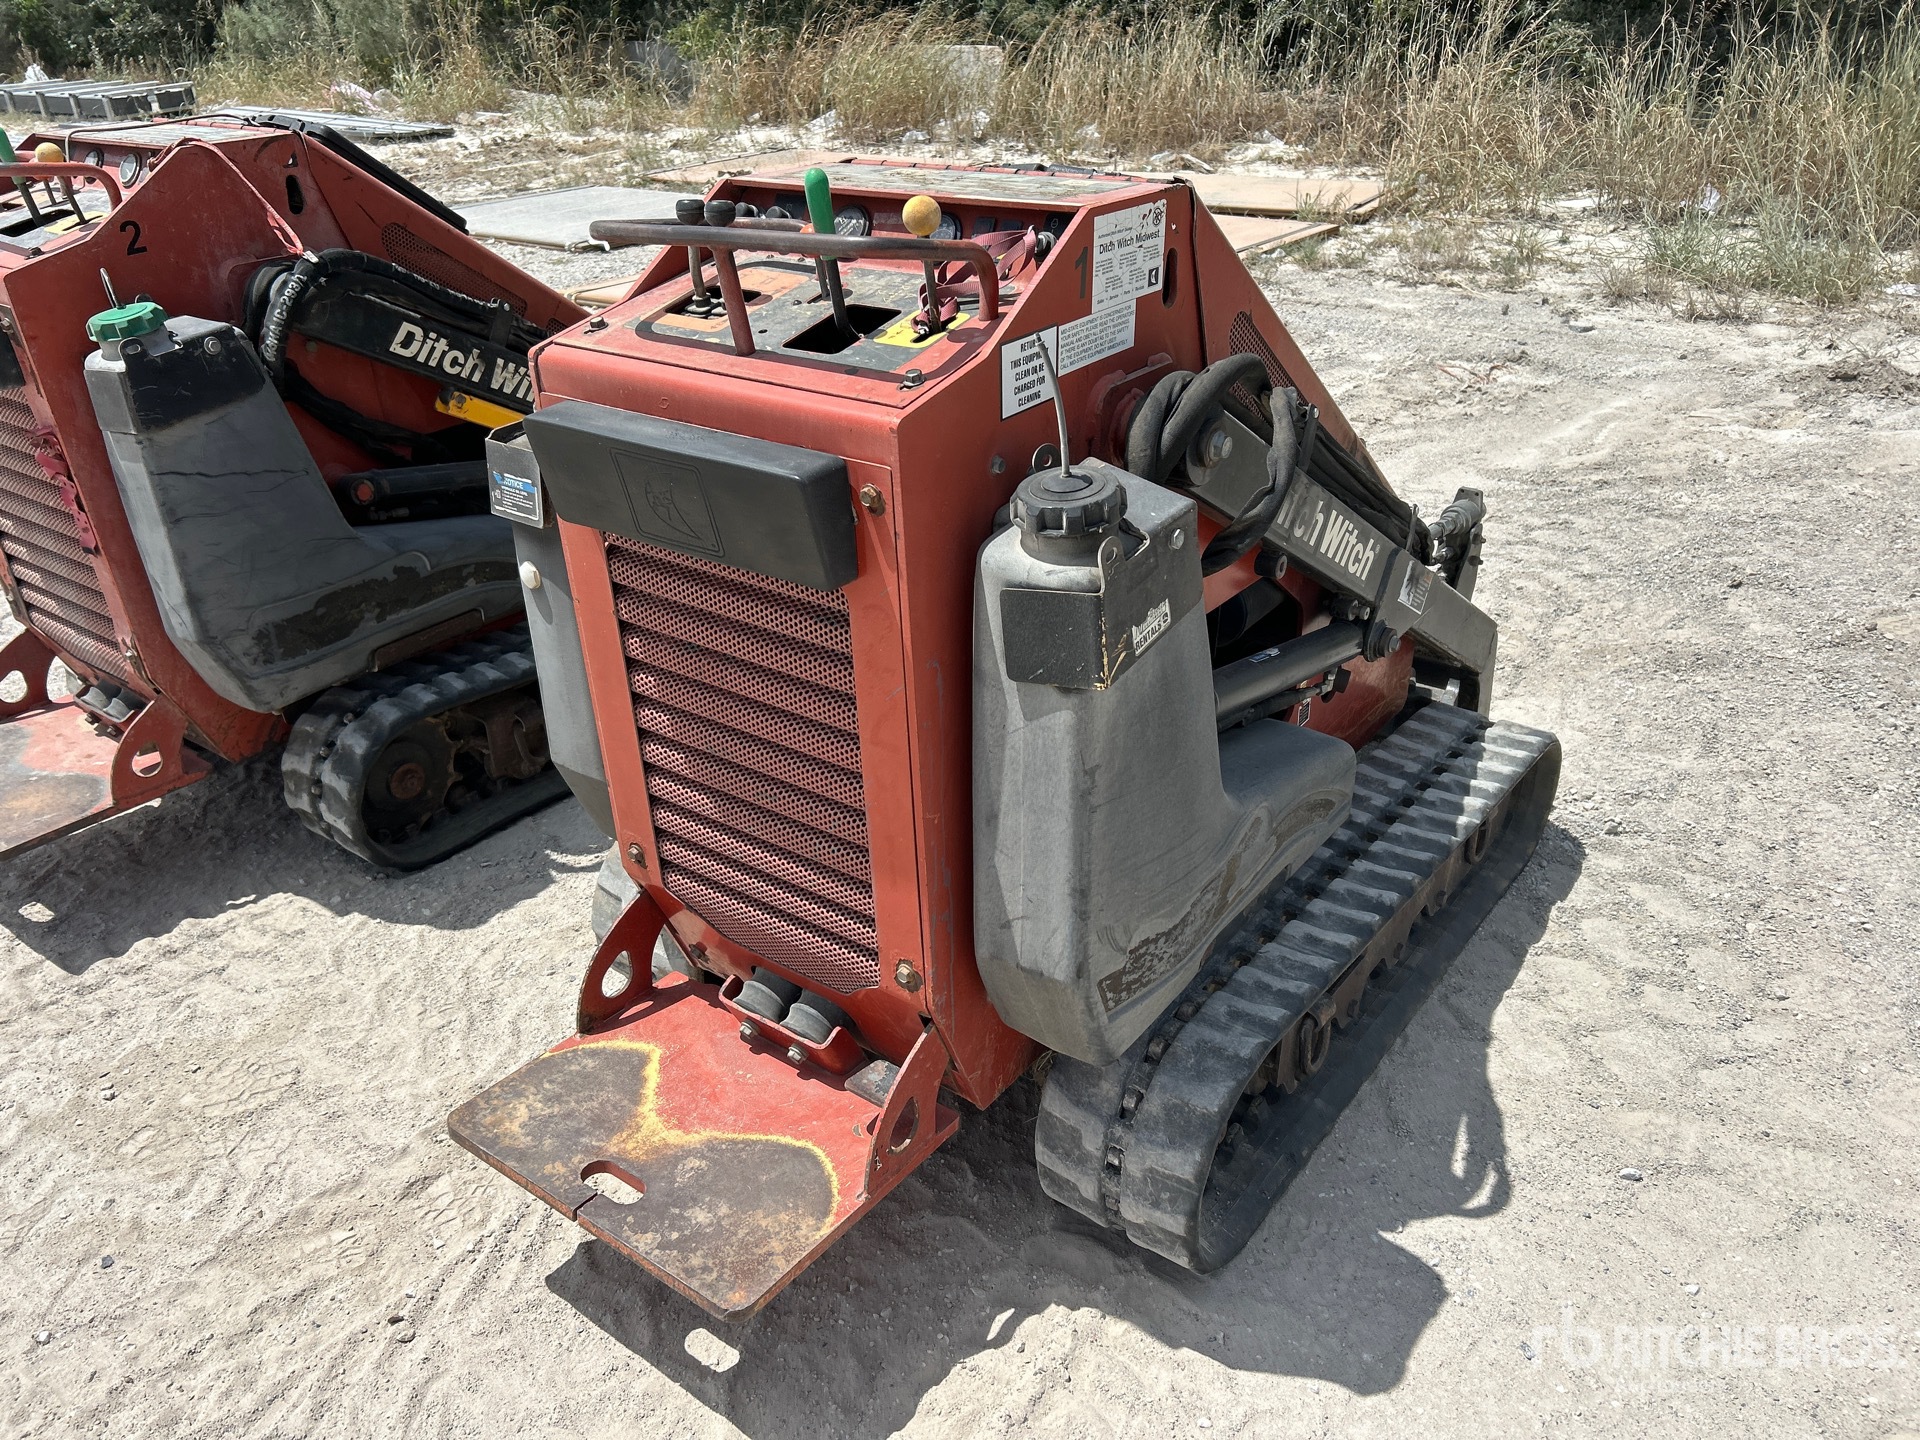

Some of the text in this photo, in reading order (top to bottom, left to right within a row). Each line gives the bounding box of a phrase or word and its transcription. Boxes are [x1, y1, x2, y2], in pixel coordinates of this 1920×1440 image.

[120, 220, 147, 256] 2
[1099, 229, 1160, 255] Ditch Witch Midwest
[1075, 246, 1088, 299] 1
[1079, 316, 1099, 329] EQUIPMENT
[1103, 308, 1124, 320] CONCERNED
[1060, 339, 1075, 349] MANUAL
[1075, 336, 1083, 344] AND
[1083, 332, 1093, 341] OBEY
[1099, 325, 1112, 335] SAFETY
[1061, 334, 1071, 342] YOUR
[1085, 322, 1099, 332] PLEASE
[1098, 320, 1108, 328] READ
[1065, 345, 1076, 354] THERE
[1088, 336, 1100, 345] DOUBT
[1116, 324, 1129, 334] SAFETY
[389, 321, 486, 384] Ditch
[1020, 338, 1037, 353] RETUR
[1087, 347, 1107, 359] EQUIPMENT
[1094, 342, 1100, 350] DO
[1010, 351, 1043, 371] THIS EQUIPM
[1014, 361, 1045, 382] CLEAN OR BE
[1013, 375, 1046, 396] CHARGED FOR
[1017, 389, 1042, 407] CLEANING
[1134, 619, 1162, 652] RENTALS
